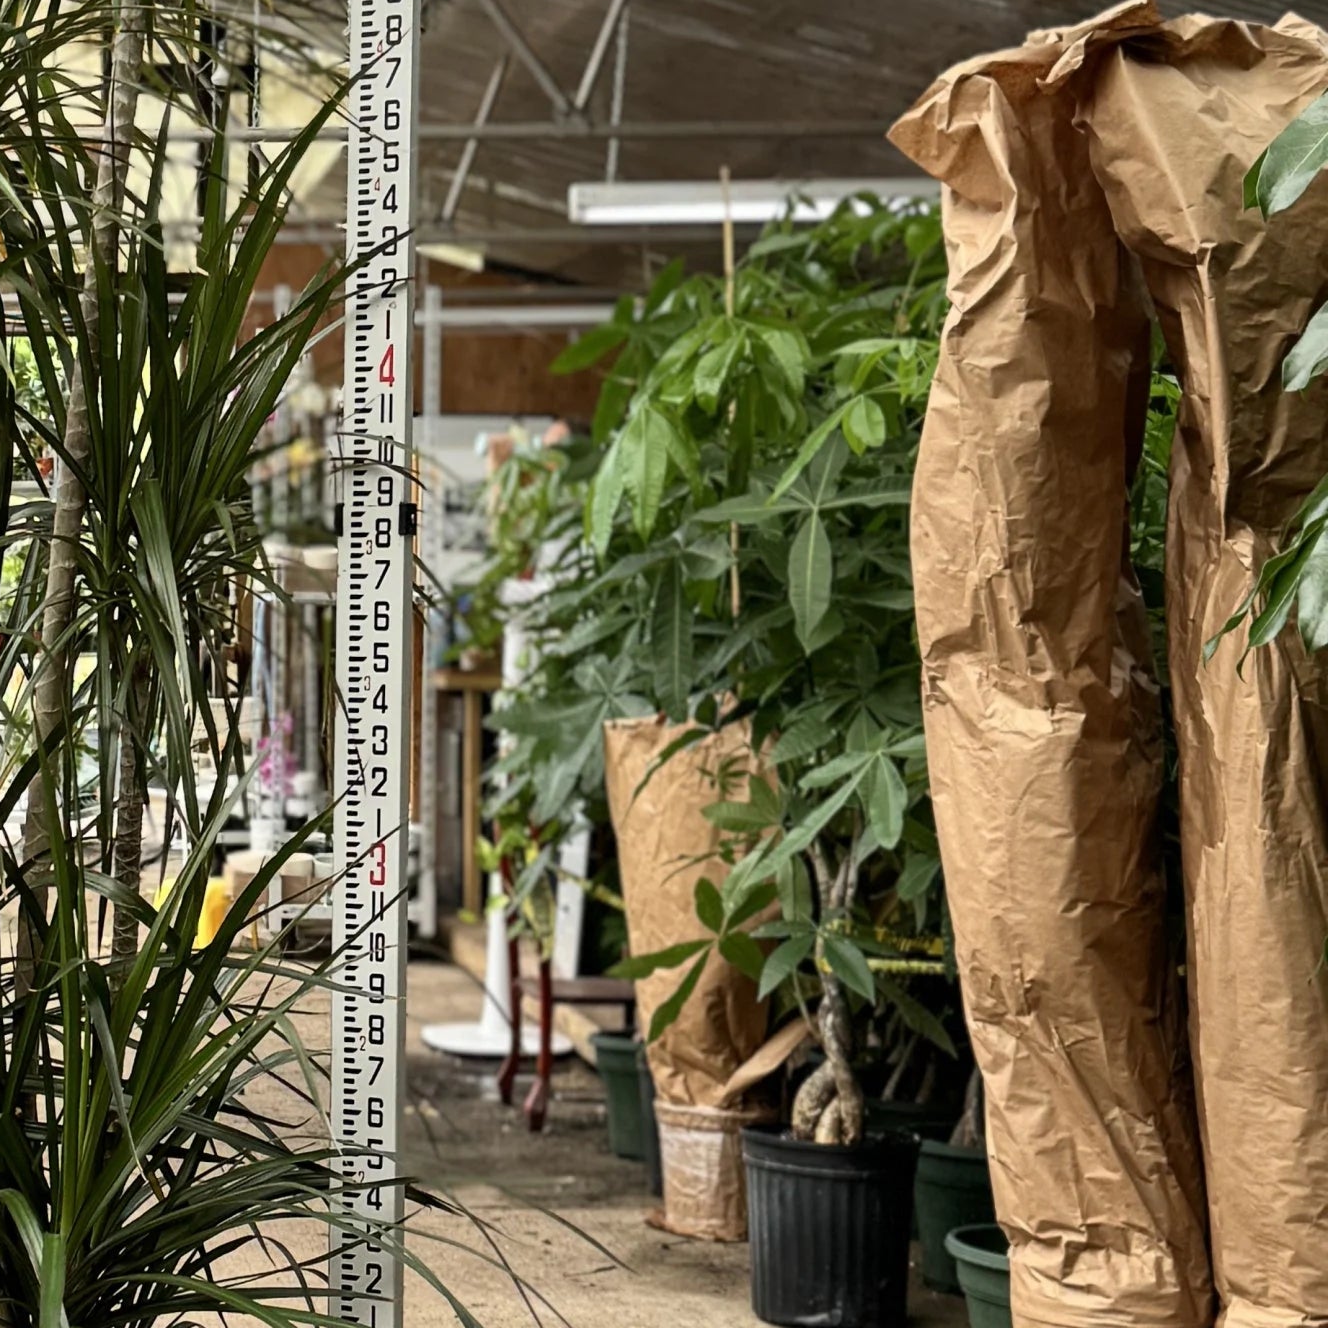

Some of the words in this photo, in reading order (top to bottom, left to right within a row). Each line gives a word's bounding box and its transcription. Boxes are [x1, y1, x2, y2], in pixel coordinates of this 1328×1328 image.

[386, 15, 402, 45] 8
[386, 57, 401, 88] 7
[385, 100, 400, 130] 6
[384, 141, 399, 172] 5
[382, 184, 398, 214] 4
[381, 268, 397, 299] 2
[379, 344, 395, 388] 4
[380, 393, 393, 423] 11
[378, 436, 393, 465] 10
[378, 476, 393, 506] 9
[375, 518, 391, 548] 8
[375, 560, 390, 590] 7
[374, 601, 390, 631] 6
[373, 642, 389, 673] 5
[372, 684, 388, 714] 4
[372, 725, 388, 755] 3
[371, 767, 387, 797] 2
[369, 843, 386, 886] 3
[372, 891, 383, 921] 11
[370, 932, 385, 962] 10
[369, 973, 385, 1004] 9
[359, 1036, 367, 1052] 2
[369, 1015, 384, 1045] 8
[368, 1056, 384, 1086] 7
[367, 1097, 383, 1128] 6
[367, 1139, 383, 1170] 5
[367, 1184, 382, 1210] 4
[366, 1263, 382, 1294] 2
